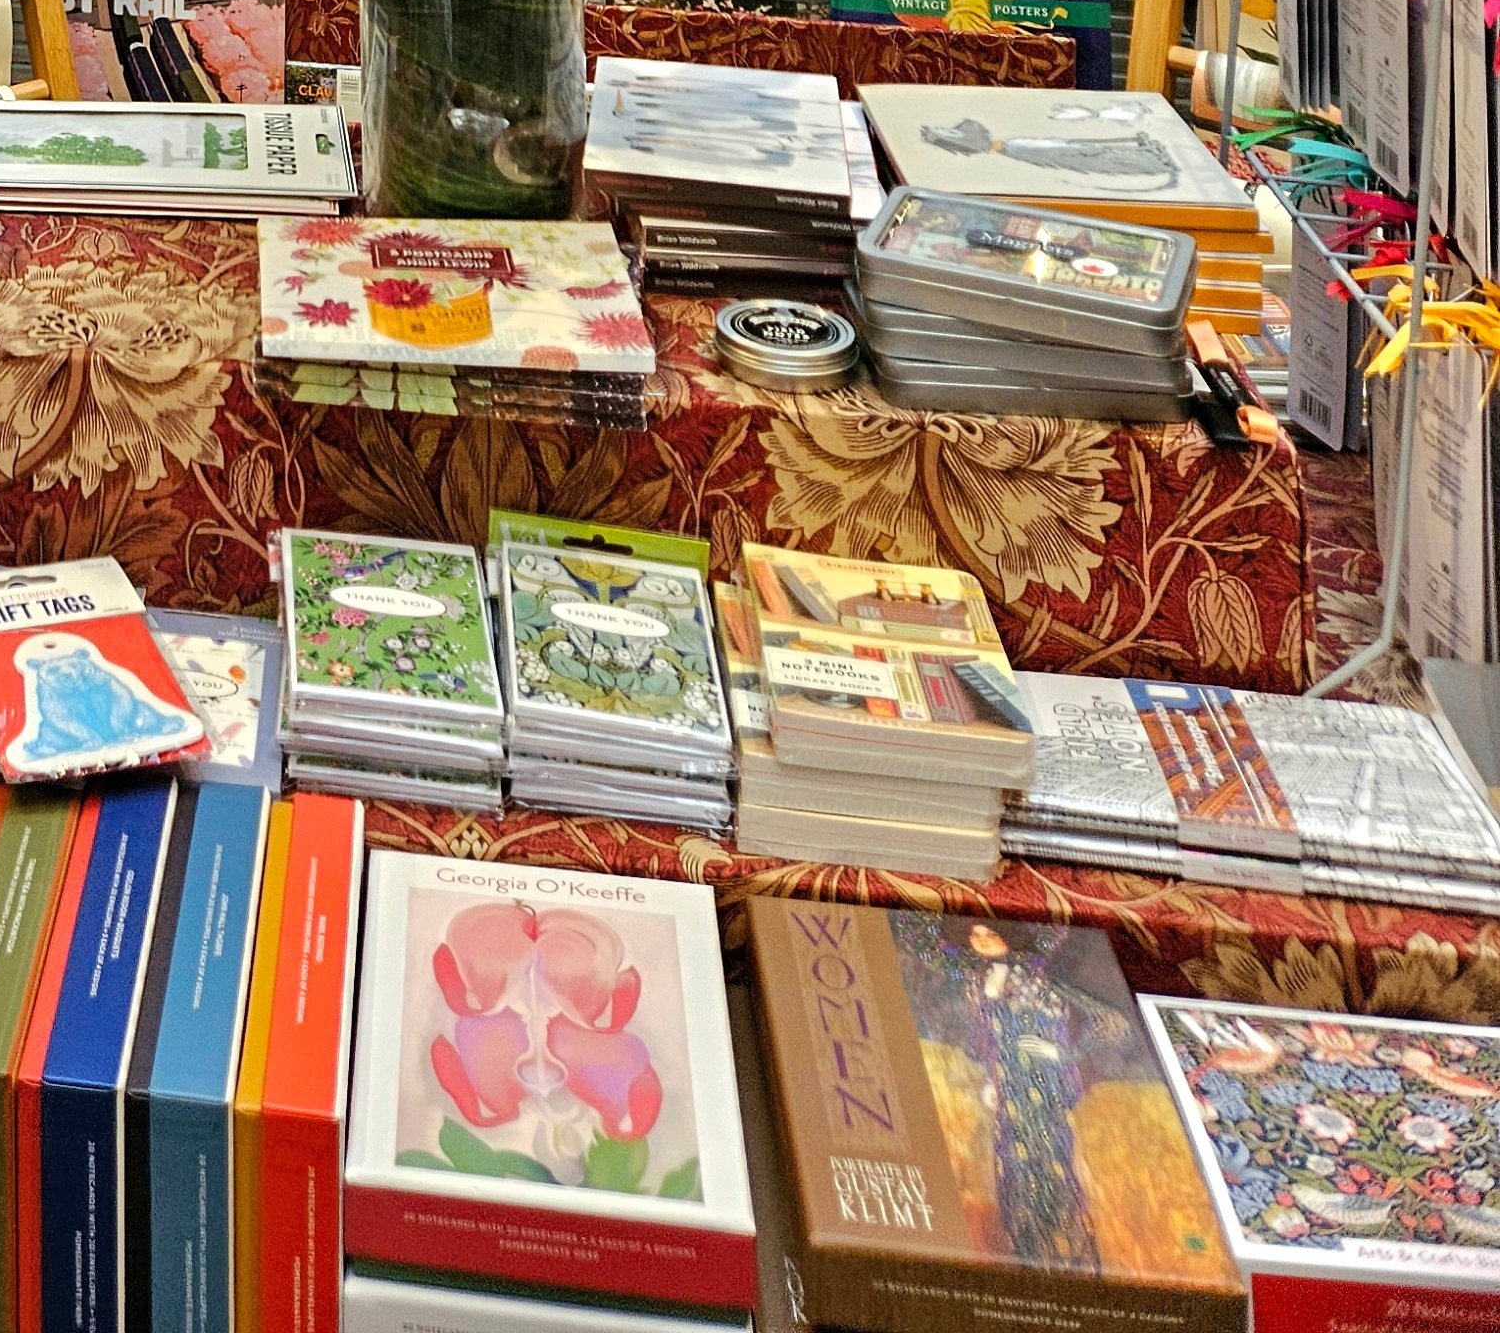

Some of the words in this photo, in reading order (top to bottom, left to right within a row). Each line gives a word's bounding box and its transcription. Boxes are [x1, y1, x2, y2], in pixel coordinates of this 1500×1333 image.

[994, 3, 1050, 19] POSTERS
[264, 112, 294, 141] TISSUE
[266, 145, 298, 175] PAPER
[657, 234, 678, 244] Brian
[678, 235, 718, 246] Wildsmith
[396, 258, 441, 268] ANGIE
[443, 259, 491, 269] LEWIN
[403, 249, 494, 259] POSTCARDS
[36, 594, 96, 616] TAGS
[345, 591, 396, 606] THANK
[401, 597, 432, 611] YOU
[565, 607, 617, 623] THANK
[622, 616, 655, 630] YOU
[780, 660, 881, 682] NOTEBOOKS
[819, 659, 854, 671] MINI
[783, 673, 834, 687] LIBRARY
[839, 681, 883, 693] BOOKS
[1053, 702, 1103, 760] FIELD
[1092, 700, 1153, 774] NOTES
[435, 866, 529, 894] Georgia
[536, 877, 647, 905] O'Keeffe
[87, 1154, 97, 1211] NOTECARDS
[833, 1171, 928, 1204] GUSTAV
[837, 1194, 935, 1232] KLIMT
